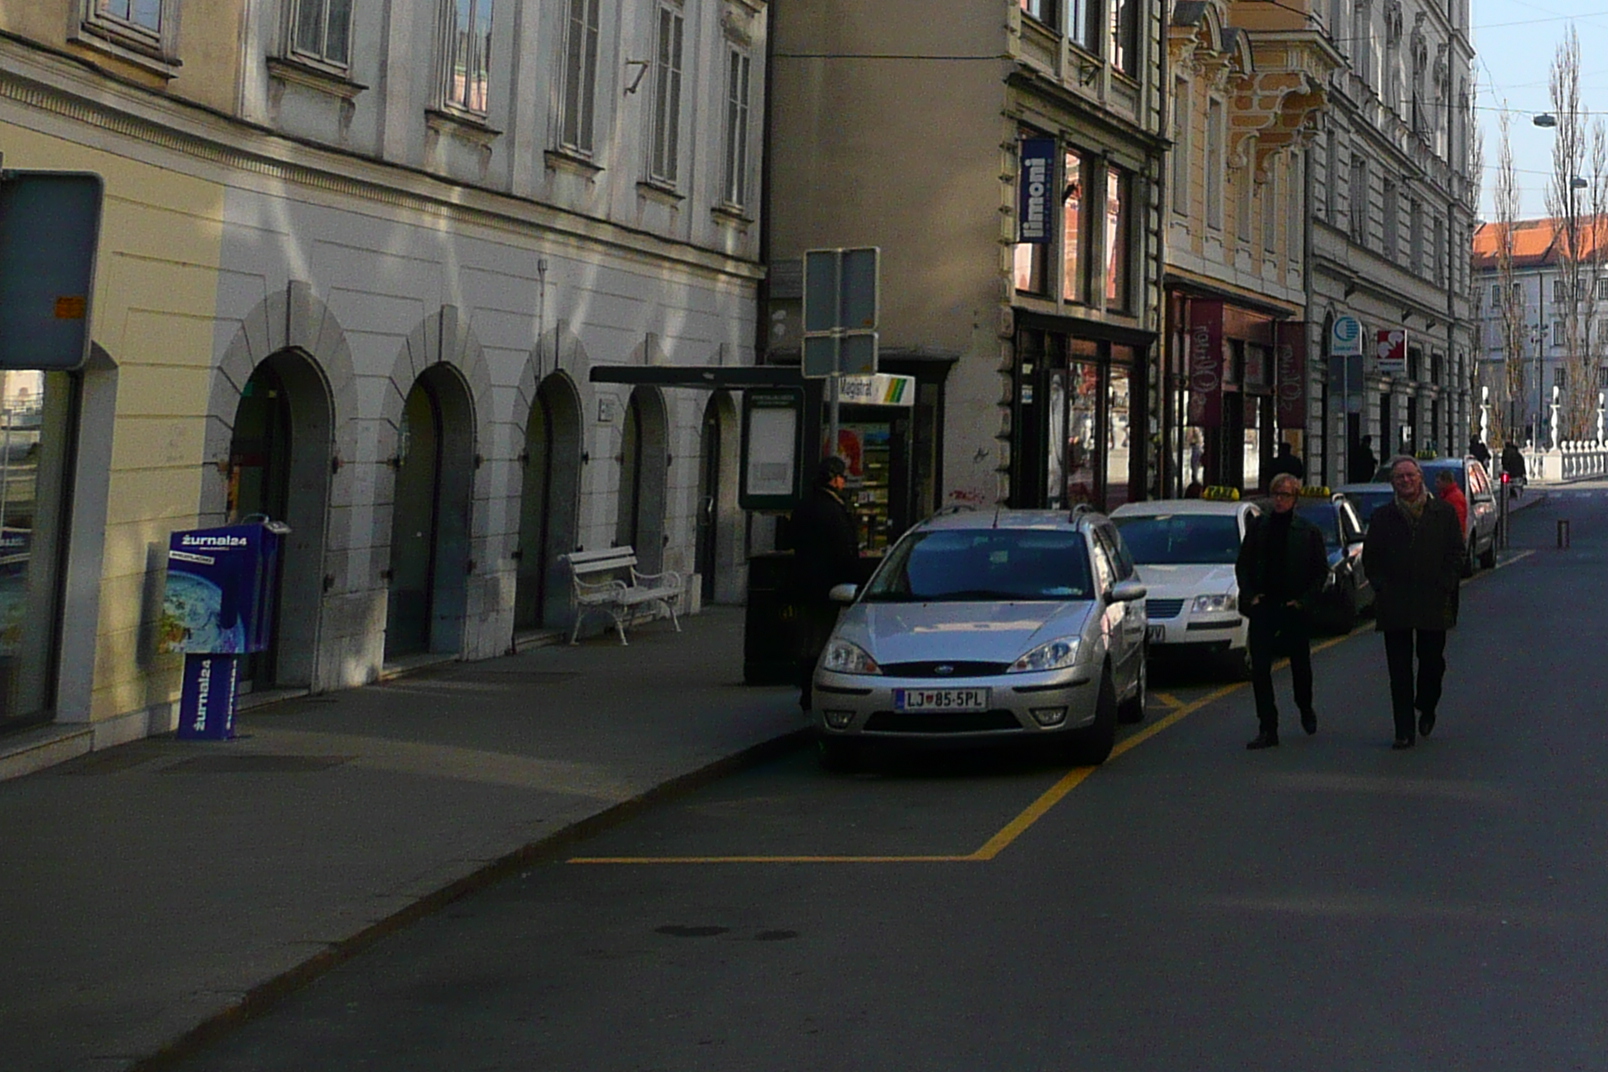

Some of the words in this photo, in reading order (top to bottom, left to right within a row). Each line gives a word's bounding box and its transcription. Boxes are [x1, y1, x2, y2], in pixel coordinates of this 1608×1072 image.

[1022, 158, 1046, 237] limoni
[181, 534, 248, 546] žurnal24
[193, 659, 212, 731] žurnal24
[907, 691, 925, 707] LJ
